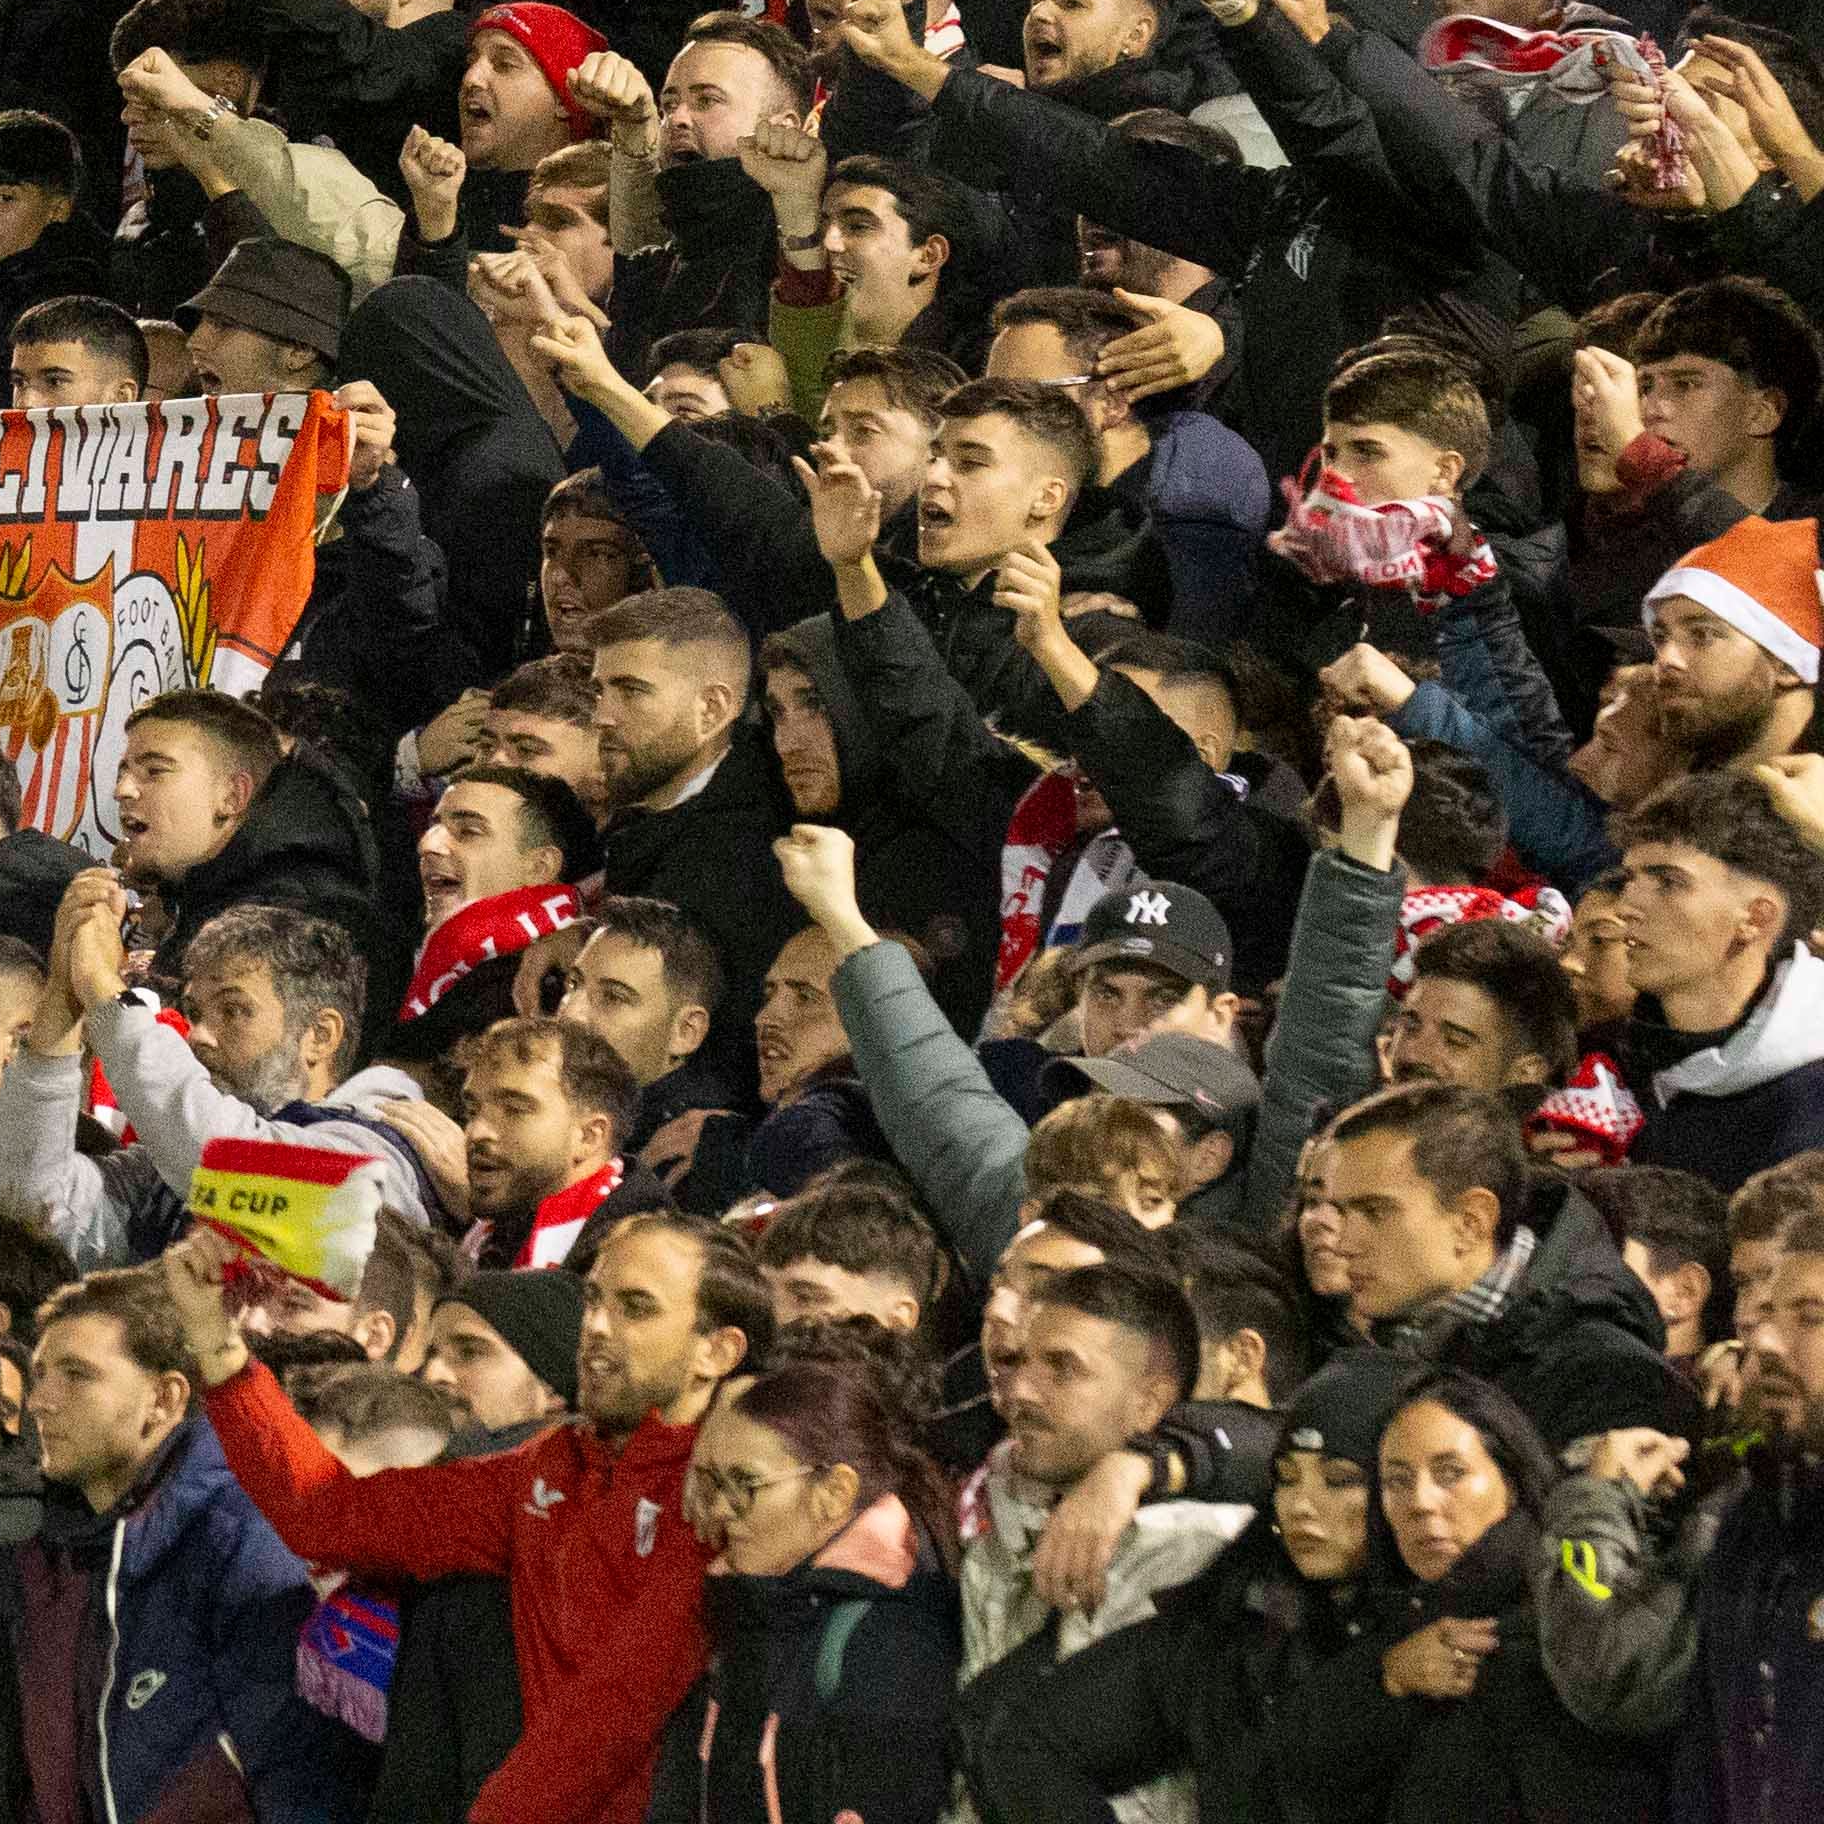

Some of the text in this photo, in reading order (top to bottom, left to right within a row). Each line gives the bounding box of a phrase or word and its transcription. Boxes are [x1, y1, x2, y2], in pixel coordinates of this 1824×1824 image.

[118, 596, 159, 633] FOOT
[1125, 890, 1172, 926] NY
[229, 1189, 289, 1215] CUP
